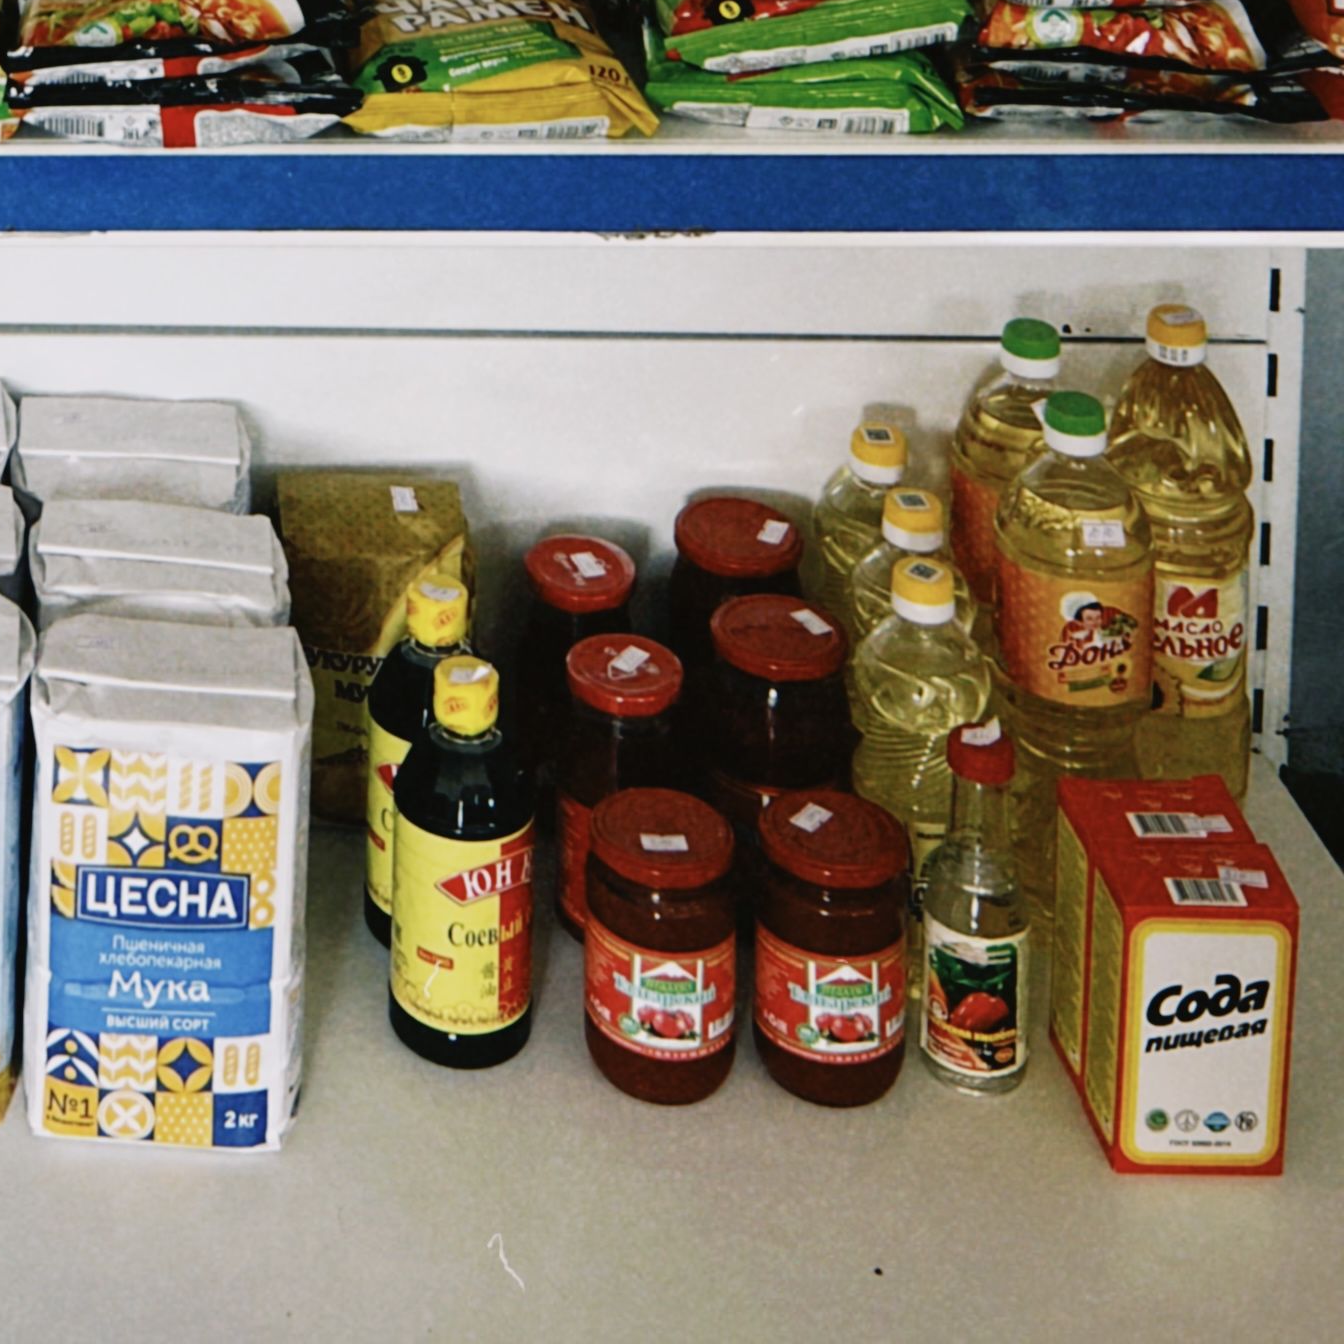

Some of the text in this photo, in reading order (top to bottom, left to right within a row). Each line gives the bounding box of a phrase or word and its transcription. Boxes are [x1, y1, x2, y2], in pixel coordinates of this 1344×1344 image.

[392, 0, 594, 33] РАМЕН
[589, 64, 621, 82] 120
[86, 875, 239, 920] ЦЕСНА
[112, 934, 205, 955] Пшеничная
[99, 951, 223, 971] хлебопекарная
[108, 970, 211, 1008] Мука
[1145, 975, 1271, 1027] Сода
[106, 1014, 210, 1032] ВЫСШИЙ СОРТ
[1145, 1016, 1268, 1055] пищевая
[47, 1090, 94, 1121] №1
